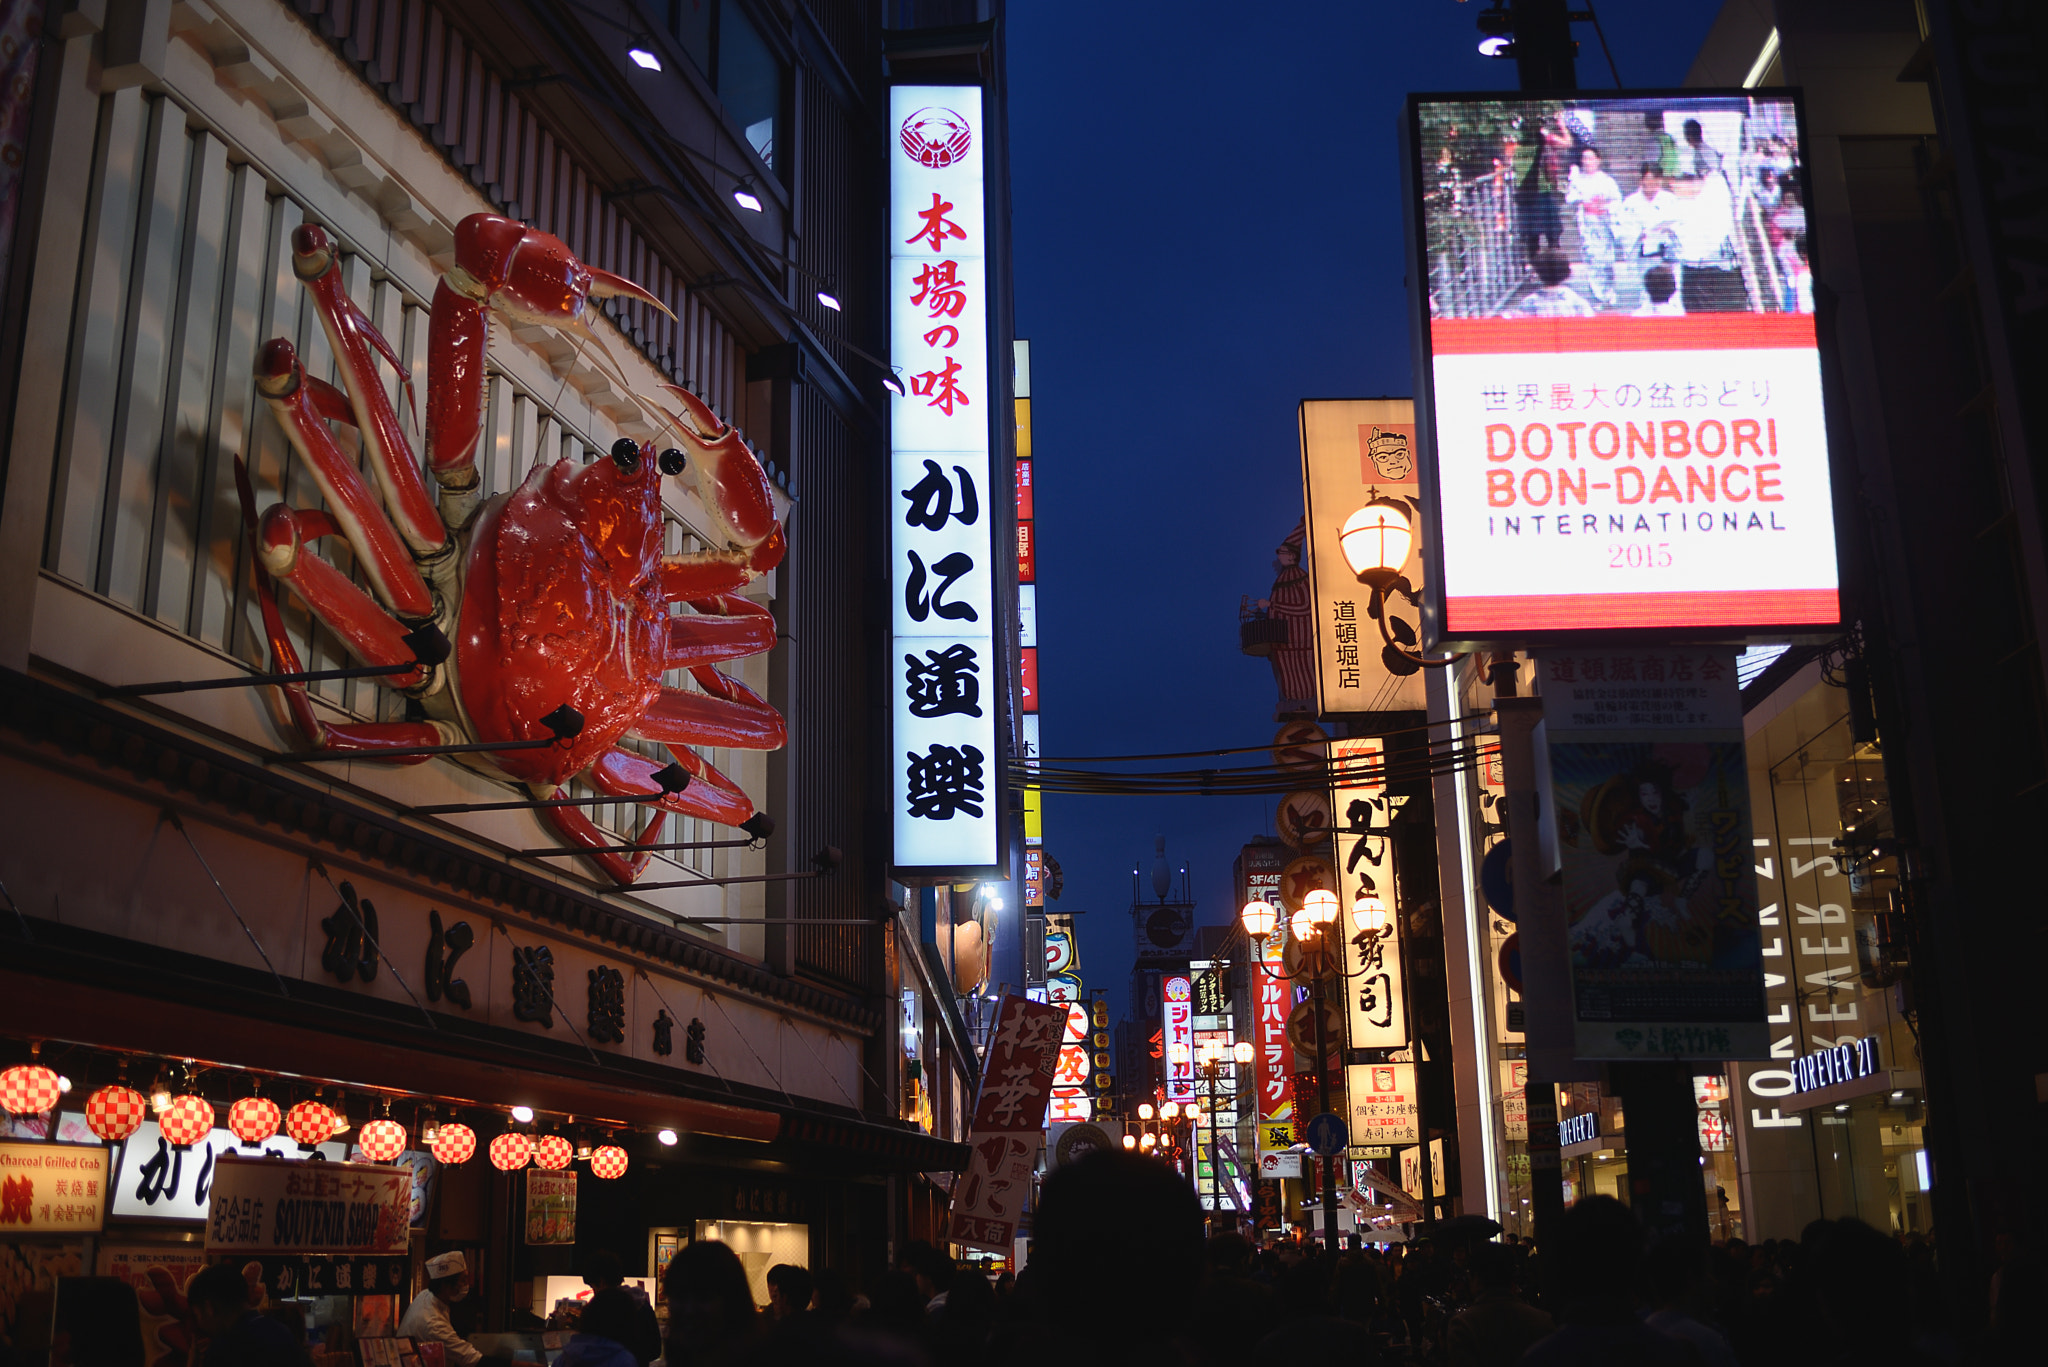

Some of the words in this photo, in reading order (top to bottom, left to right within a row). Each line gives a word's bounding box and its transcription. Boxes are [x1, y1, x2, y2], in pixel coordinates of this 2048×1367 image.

[905, 192, 970, 417] 本場の味
[1480, 379, 1771, 411] 世界最大の盆おどり
[1485, 418, 1778, 463] DOTONBORI
[1486, 463, 1785, 508] BON-DANCE
[1489, 511, 1786, 537] INTERNATIONAL
[1608, 543, 1673, 569] 2015
[1333, 601, 1359, 689] 道頓堀店
[1551, 655, 1727, 683] 道頓堀商店会
[1249, 874, 1282, 886] 3F/4F
[1711, 811, 1750, 923] ワンピース
[1260, 965, 1287, 1101] ツルハドラッグ
[1791, 1045, 1853, 1094] FOREVER
[1857, 1038, 1873, 1078] 21
[1365, 1126, 1414, 1139] 寿司・和食
[0, 1154, 41, 1168] Charcoal
[45, 1156, 76, 1168] Grilled
[80, 1157, 100, 1169] Crab
[287, 1172, 375, 1197] お土産コーナー
[274, 1199, 345, 1245] SOUVENIR
[347, 1202, 379, 1245] SHOP
[961, 1218, 1006, 1244] 入荷
